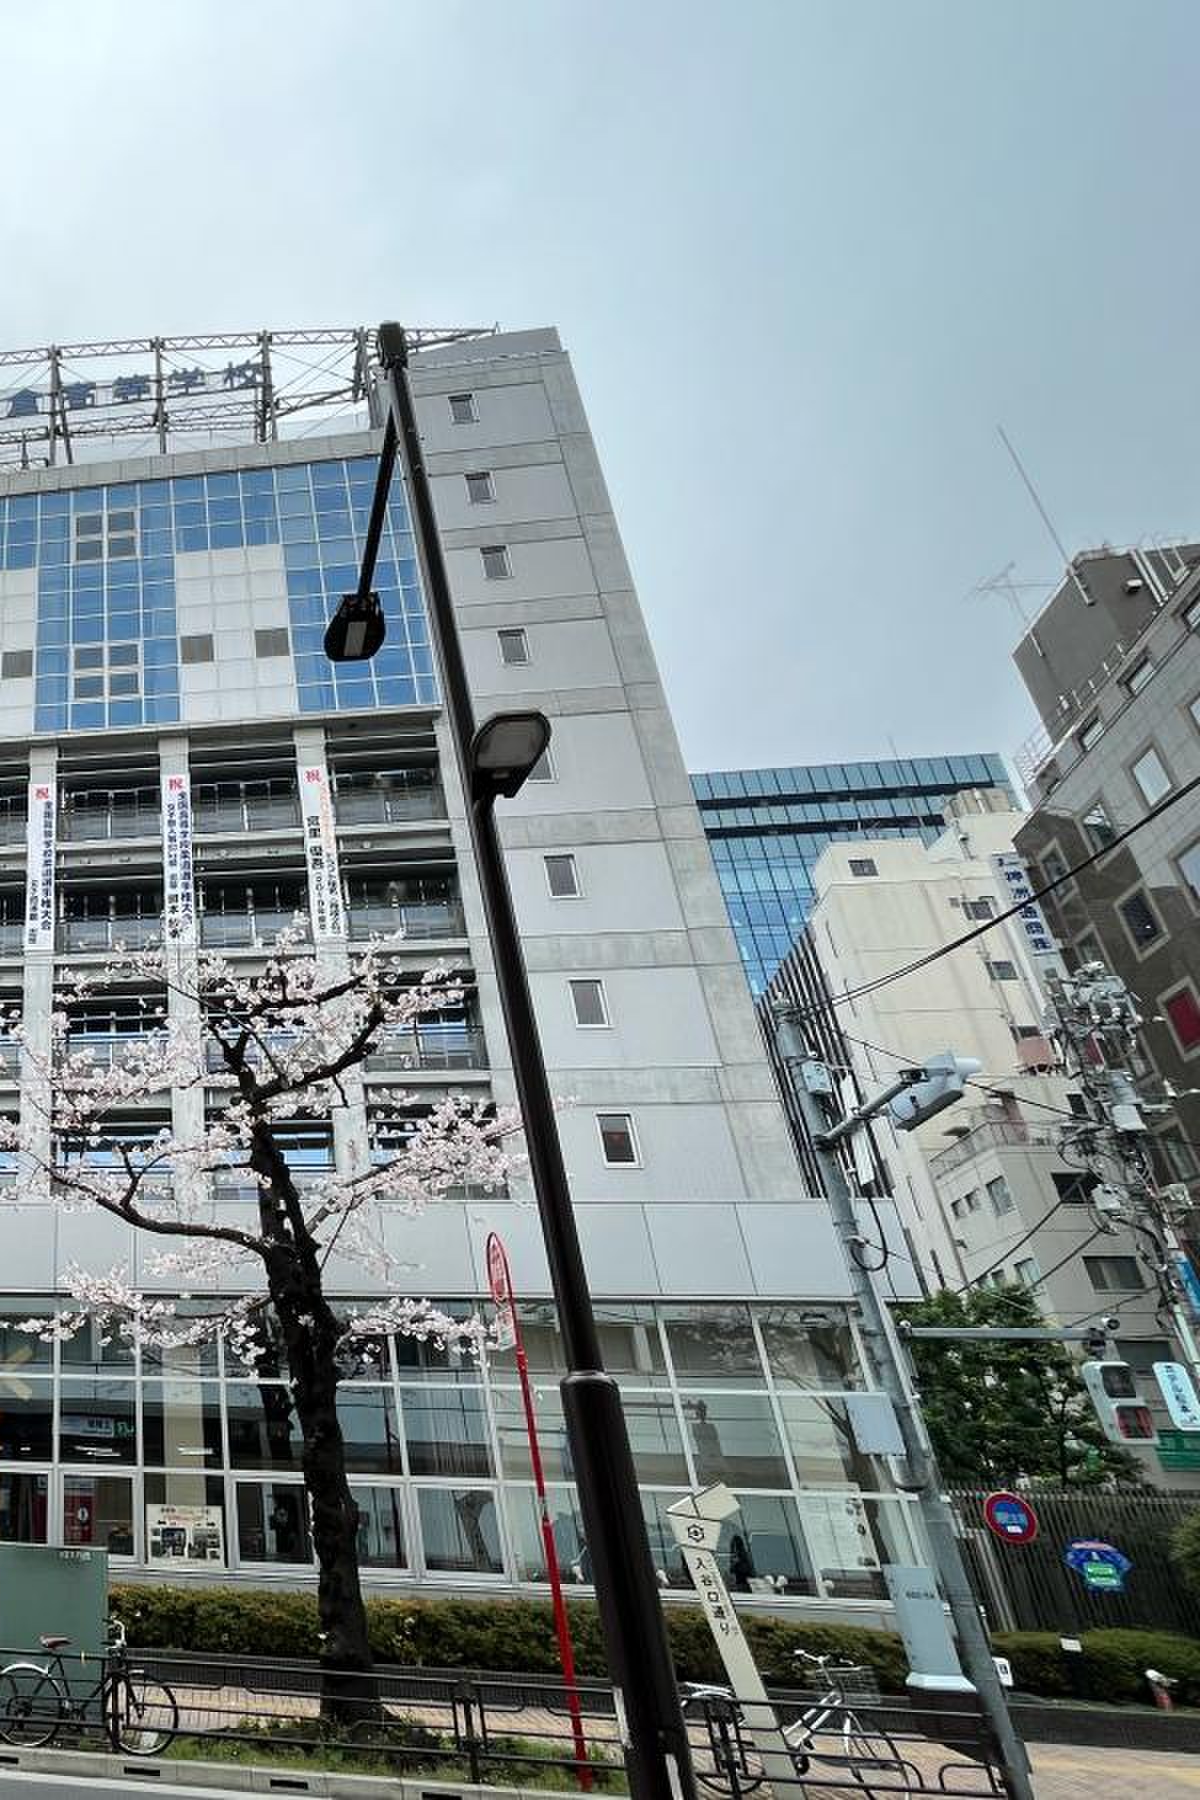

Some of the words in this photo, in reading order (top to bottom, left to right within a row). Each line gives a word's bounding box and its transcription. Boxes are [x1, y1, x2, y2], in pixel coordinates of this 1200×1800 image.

[696, 1557, 728, 1636] 入谷口通り
